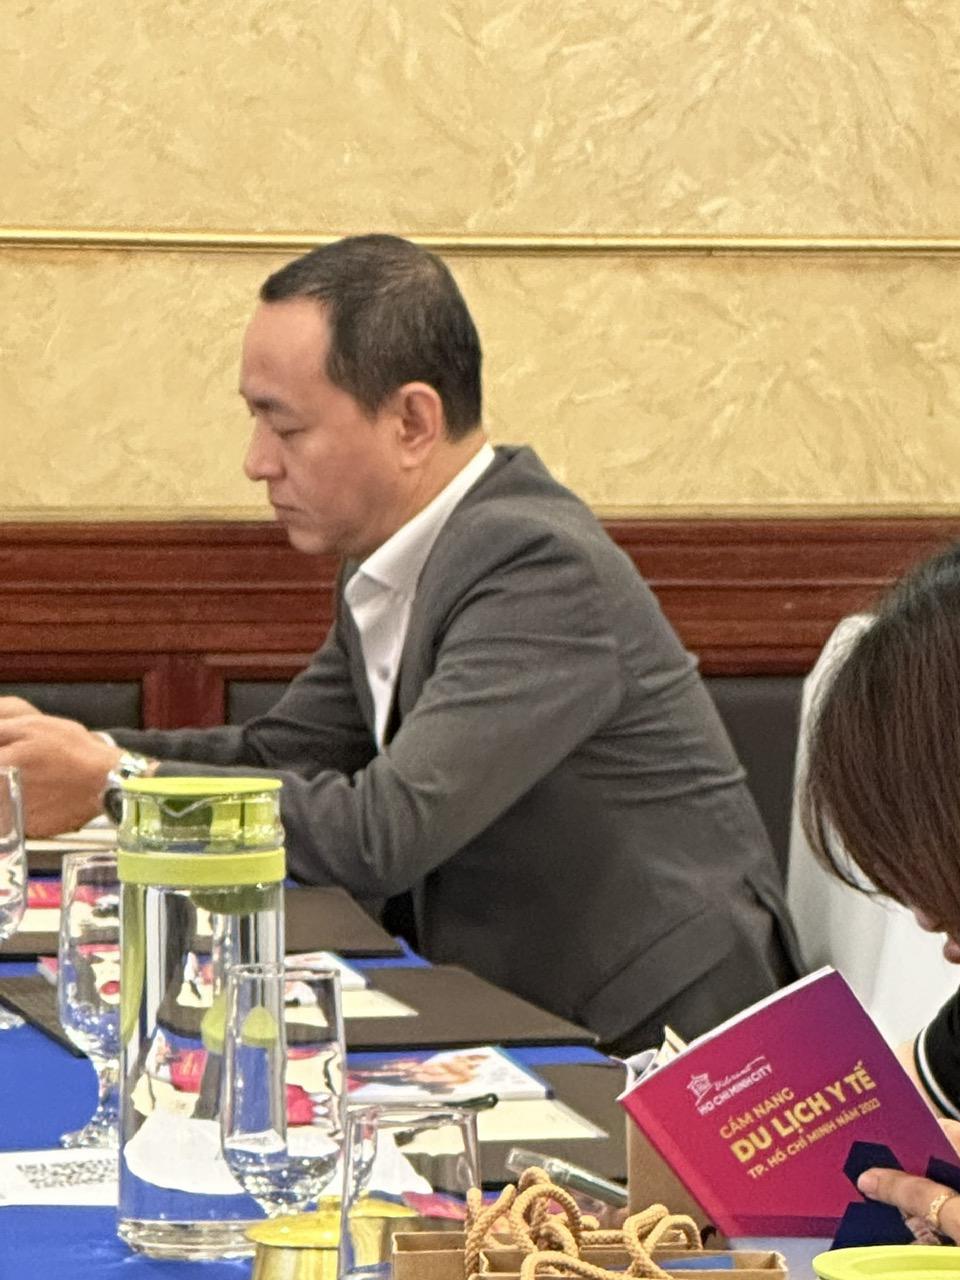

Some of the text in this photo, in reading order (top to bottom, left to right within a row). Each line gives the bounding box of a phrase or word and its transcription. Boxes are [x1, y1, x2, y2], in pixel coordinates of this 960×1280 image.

[751, 1063, 773, 1083] CITY
[730, 1059, 877, 1164] DU LỊCH Y TẾ
[752, 1087, 795, 1119] NANG
[747, 1163, 769, 1179] TP.
